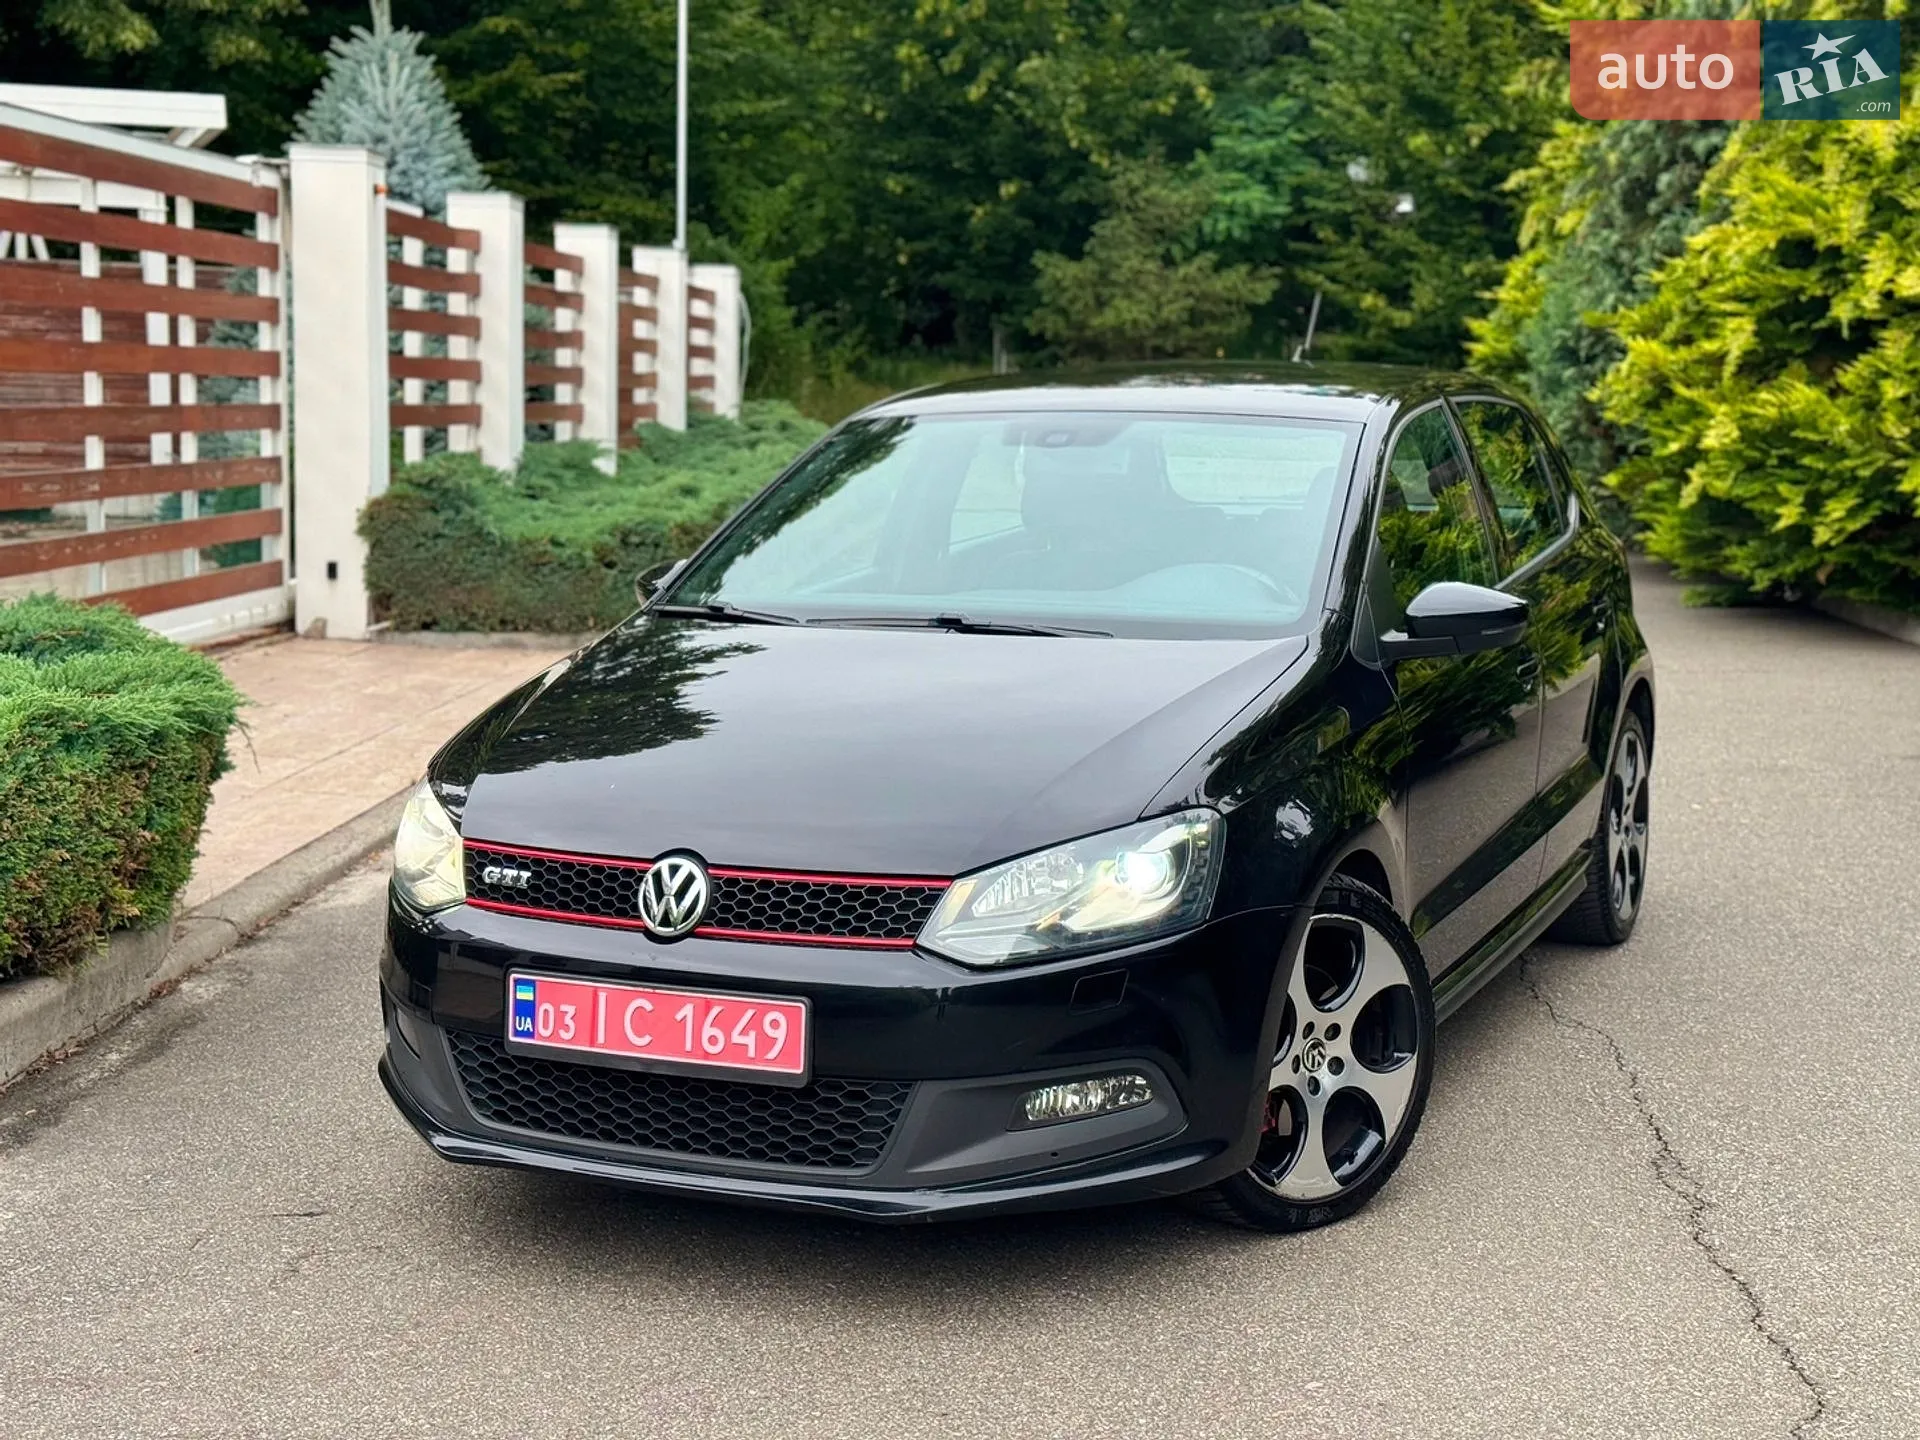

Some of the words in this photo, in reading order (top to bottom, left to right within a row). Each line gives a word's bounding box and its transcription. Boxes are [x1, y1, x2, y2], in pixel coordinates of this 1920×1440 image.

[482, 866, 532, 889] GTI
[515, 1016, 533, 1033] UA
[537, 1002, 577, 1041] 03
[674, 1001, 788, 1060] 1649
